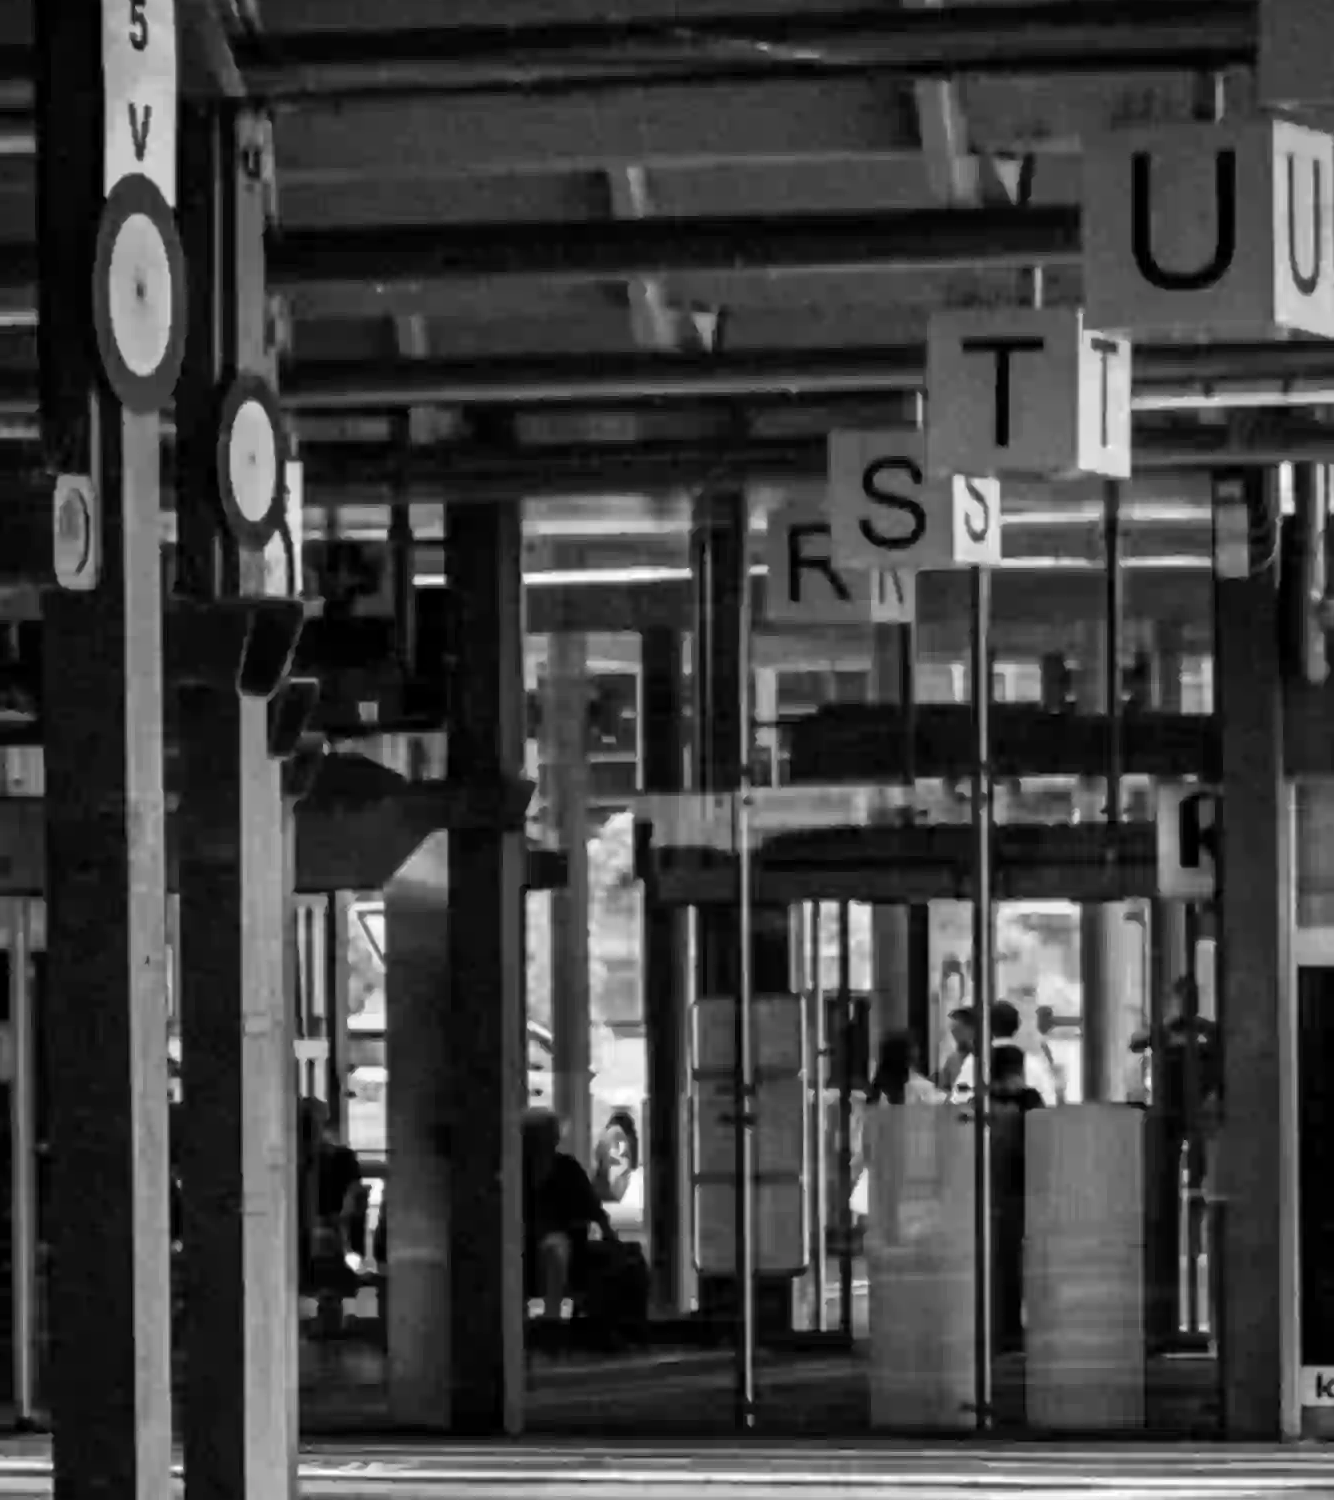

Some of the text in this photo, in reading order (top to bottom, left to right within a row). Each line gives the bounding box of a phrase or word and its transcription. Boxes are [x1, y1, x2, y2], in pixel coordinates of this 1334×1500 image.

[127, 102, 153, 160] V
[1131, 152, 1235, 289] U
[1289, 153, 1320, 295] U
[963, 336, 1043, 447] T
[1091, 337, 1119, 448] T
[860, 457, 927, 549] S
[788, 524, 851, 602] R
